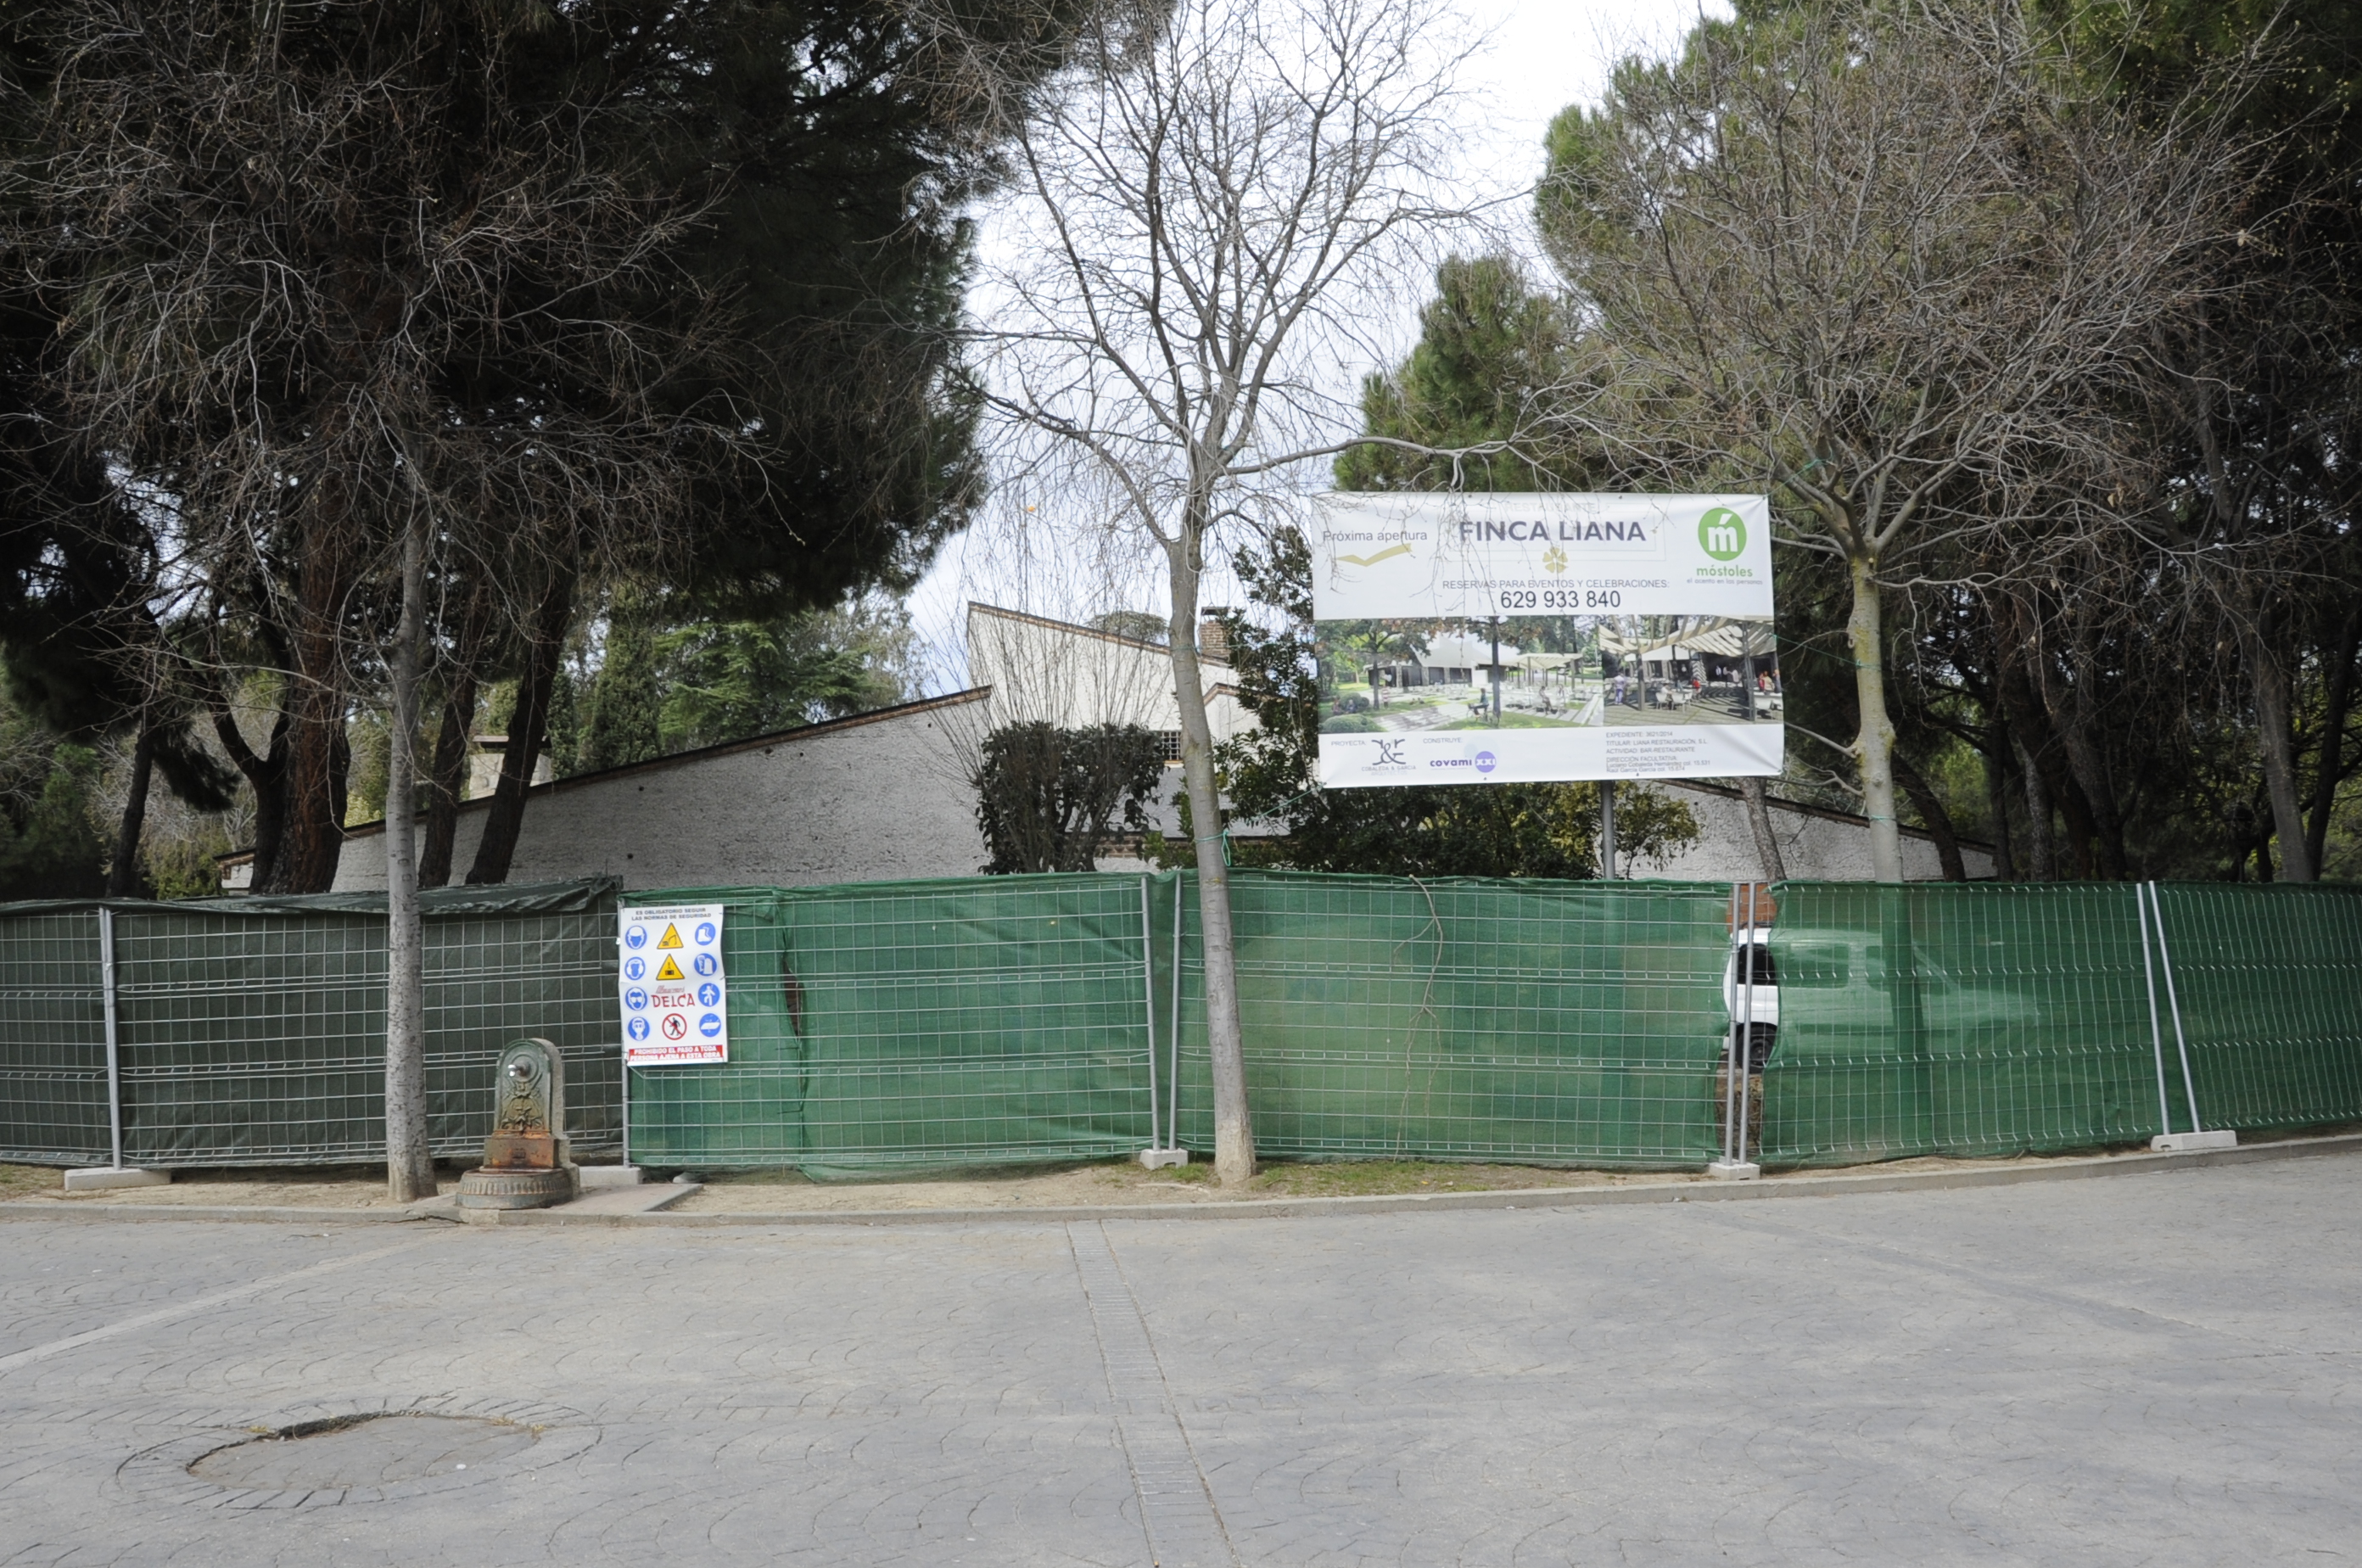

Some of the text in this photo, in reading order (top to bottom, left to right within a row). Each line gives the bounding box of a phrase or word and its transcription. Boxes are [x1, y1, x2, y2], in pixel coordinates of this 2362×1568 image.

[1504, 502, 1597, 512] RESTAURANTE
[1323, 529, 1428, 543] Próxima apertura
[1459, 520, 1647, 541] FINCA LIANA
[1696, 564, 1753, 577] móstoles
[1442, 579, 1670, 589] RESERVAS PARA EVENTOS Y CELEBRACIONES:
[1500, 591, 1620, 608] 629 933 840
[1430, 759, 1472, 767] covami
[650, 993, 696, 1008] DELCA
